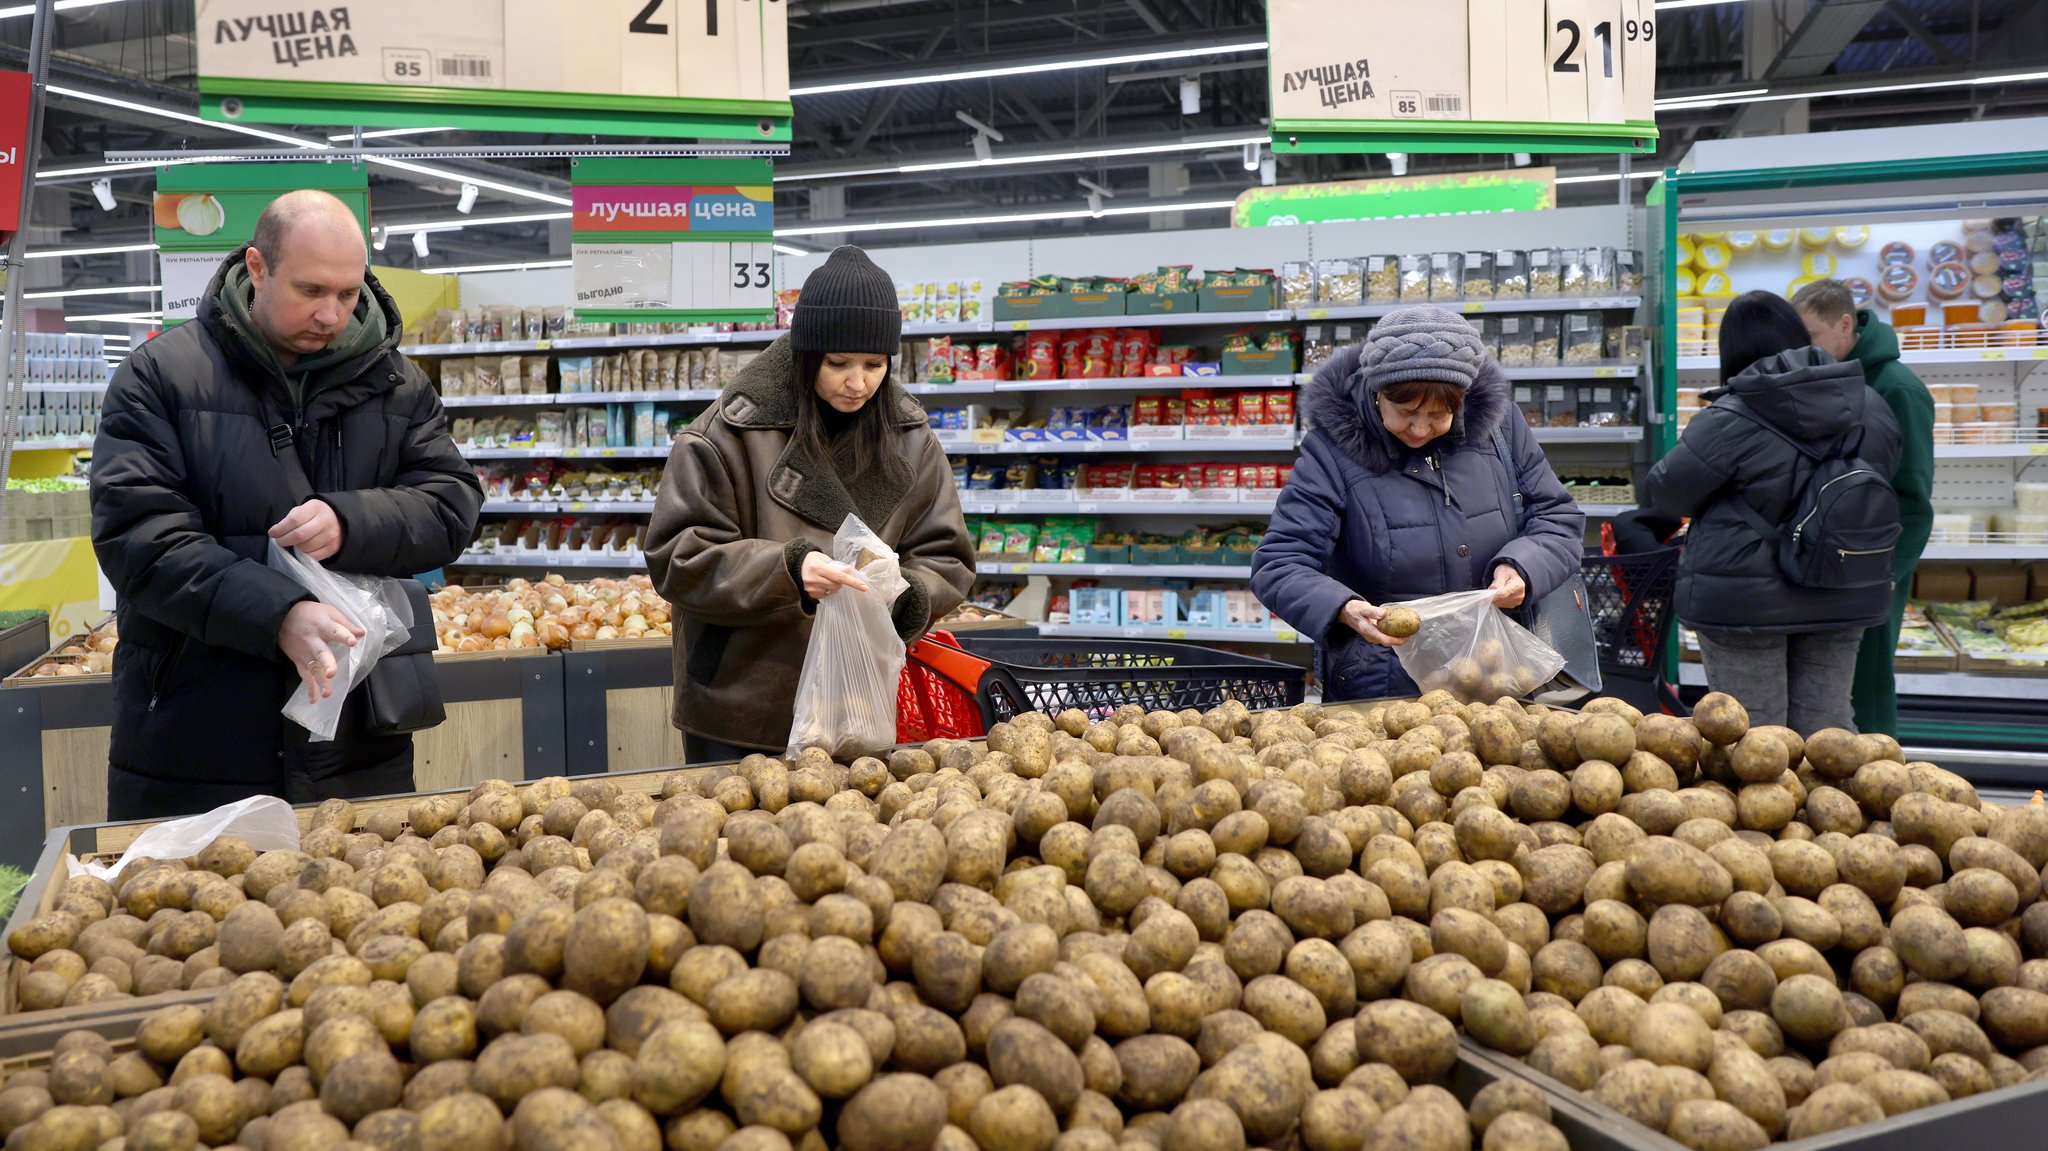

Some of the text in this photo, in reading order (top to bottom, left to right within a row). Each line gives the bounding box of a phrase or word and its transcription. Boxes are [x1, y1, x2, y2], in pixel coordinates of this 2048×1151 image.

[214, 6, 352, 44] ЛУЧШАЯ
[272, 33, 359, 67] ЦЕНА
[1553, 18, 1655, 78] 21 99
[394, 61, 422, 77] 85
[1283, 58, 1370, 93] ЛУЧШАЯ
[1319, 79, 1376, 110] ЦЕНА
[1398, 100, 1417, 114] 85
[589, 201, 757, 223] лучшая цена
[733, 262, 771, 289] 33
[577, 285, 624, 301] ВЫГОДНО
